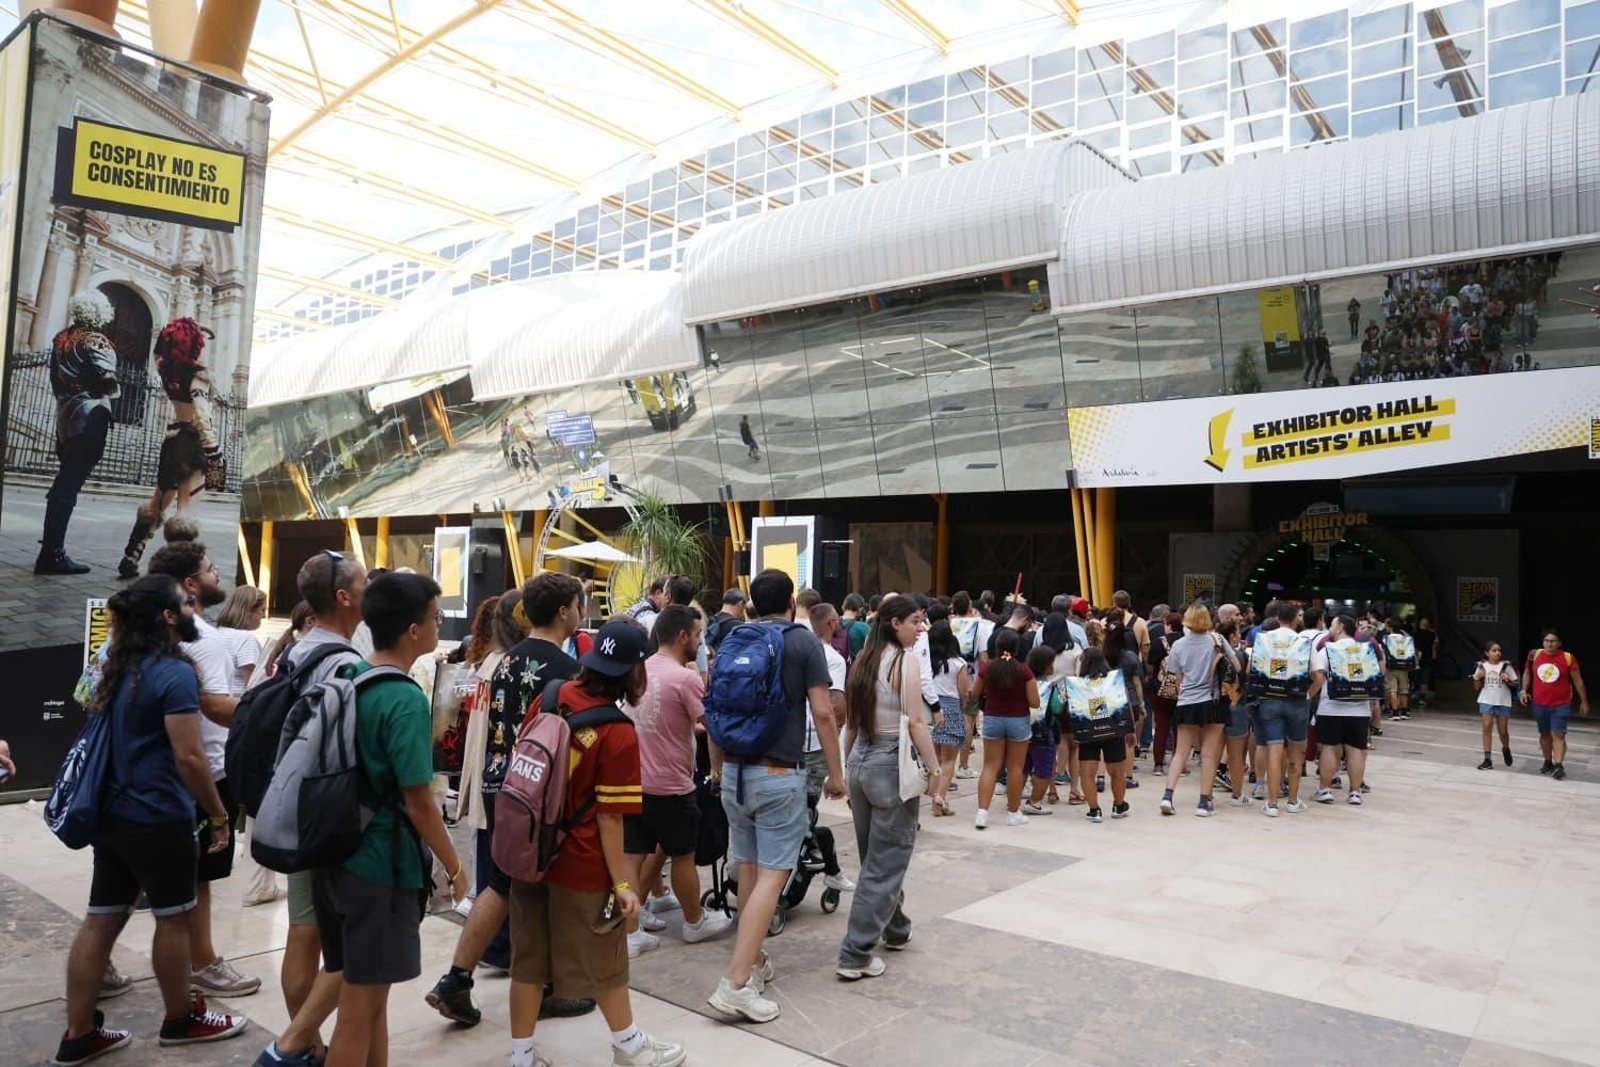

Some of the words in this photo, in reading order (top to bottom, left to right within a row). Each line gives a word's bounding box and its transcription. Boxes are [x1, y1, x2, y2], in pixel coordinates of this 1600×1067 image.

[89, 140, 167, 172] COSPLAY
[172, 157, 194, 177] NO
[199, 162, 218, 183] ES
[87, 163, 230, 205] CONSENTIMIENTO
[1252, 405, 1373, 439] EXHIBITOR
[1376, 395, 1439, 419] HALL
[1256, 432, 1353, 463] ARTISTS'
[1357, 421, 1433, 447] ALLEY
[592, 477, 607, 499] 5
[1279, 512, 1368, 533] EXHIBITOR
[1302, 527, 1343, 543] HALL
[600, 636, 617, 655] NY
[511, 751, 547, 783] VANS
